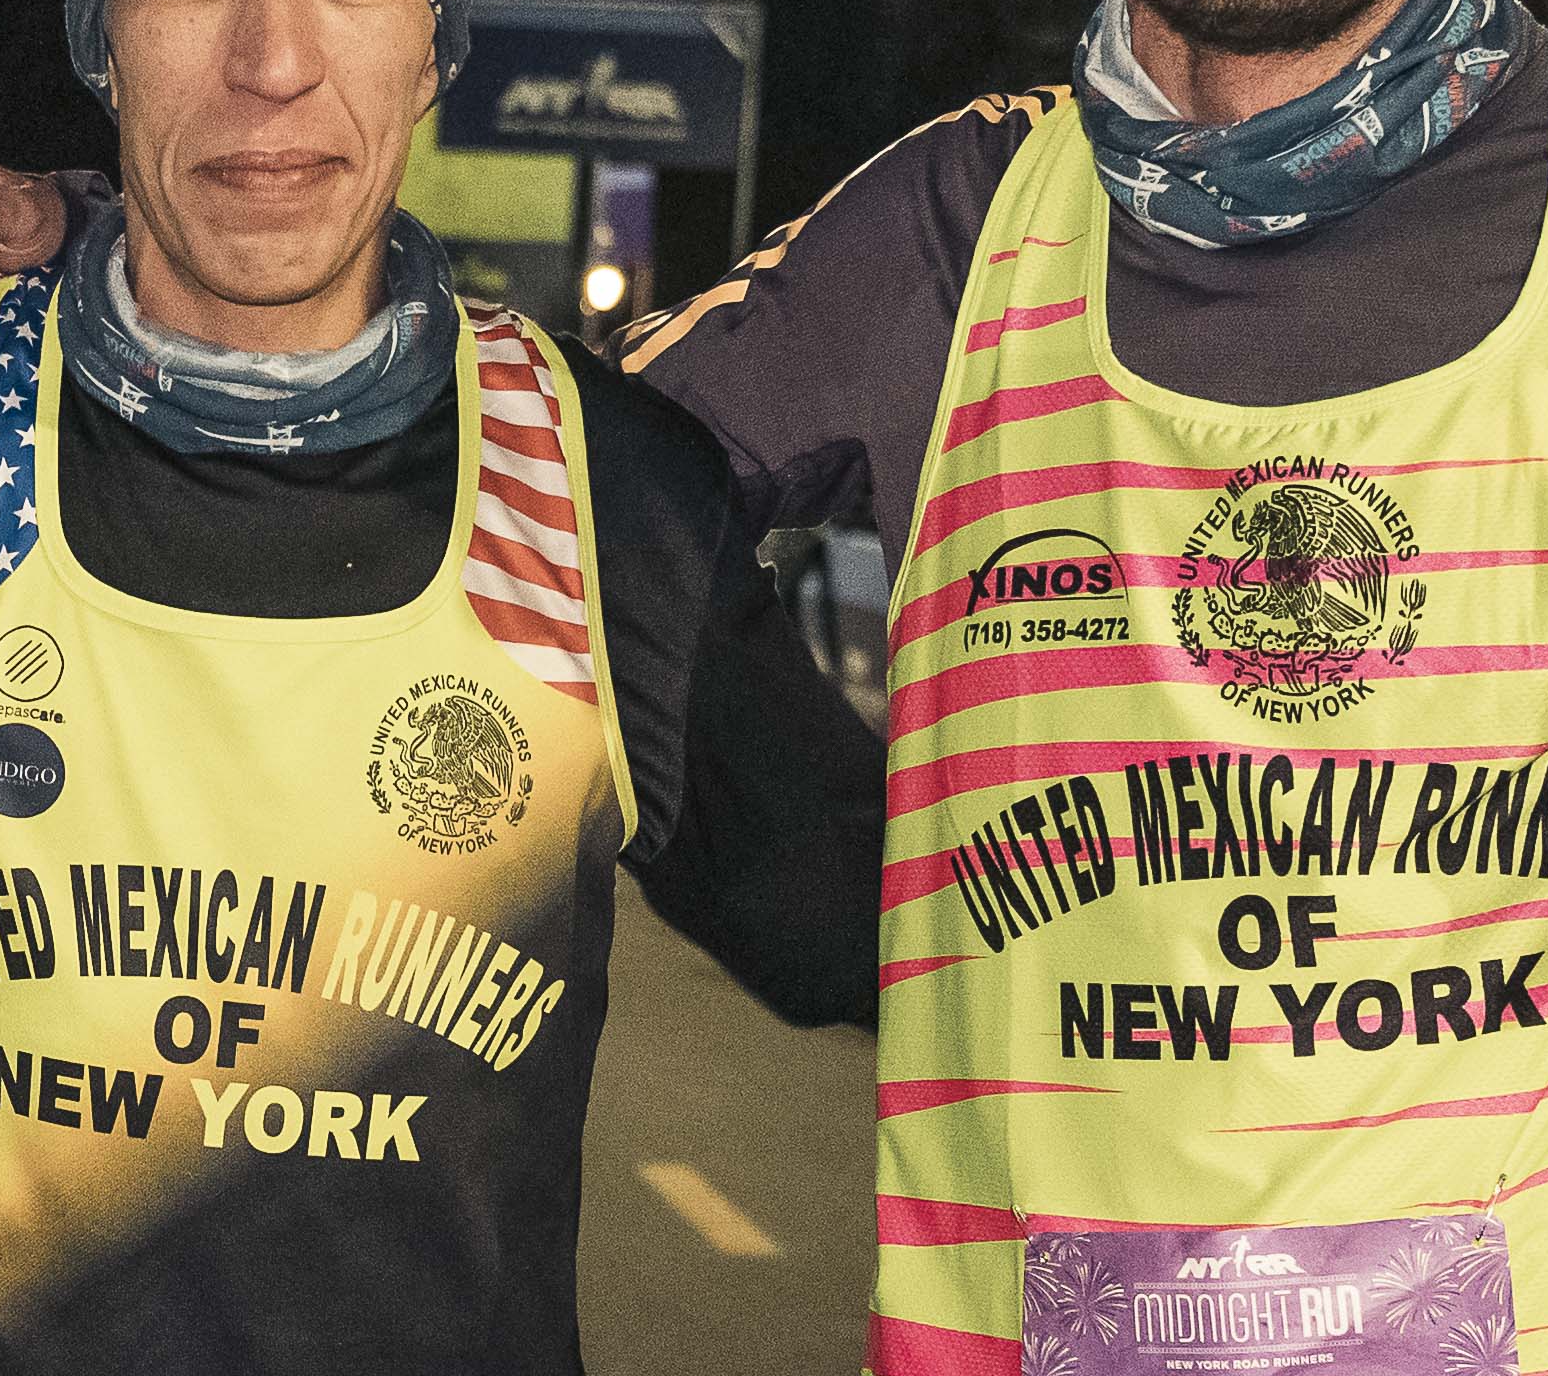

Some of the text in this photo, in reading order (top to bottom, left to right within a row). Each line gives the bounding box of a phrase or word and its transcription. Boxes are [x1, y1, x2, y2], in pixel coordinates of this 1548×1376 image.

[1178, 455, 1420, 581] UNITED MEXICAN RUNNERS
[965, 562, 1114, 616] XINOS
[963, 616, 1130, 653] (718) 358-4272
[370, 675, 532, 762] UNITED MEXICAN RUNNERS
[1220, 676, 1375, 724] OF NEW YORK
[398, 823, 498, 855] OF NEW YORK
[950, 775, 1116, 955] UNITED
[1125, 753, 1395, 887] MEXICAN
[70, 864, 327, 994] MEXICAN
[324, 891, 565, 1072] RUNNERS
[1217, 894, 1340, 971] OF
[153, 995, 266, 1068] OF
[1059, 982, 1240, 1063] NEW
[190, 1082, 429, 1161] YORK
[1176, 1243, 1307, 1279] NYRR
[1134, 1284, 1363, 1344] MIDNIGHT RUN
[1166, 1352, 1335, 1370] NEW YORK ROAD RUNNERS
